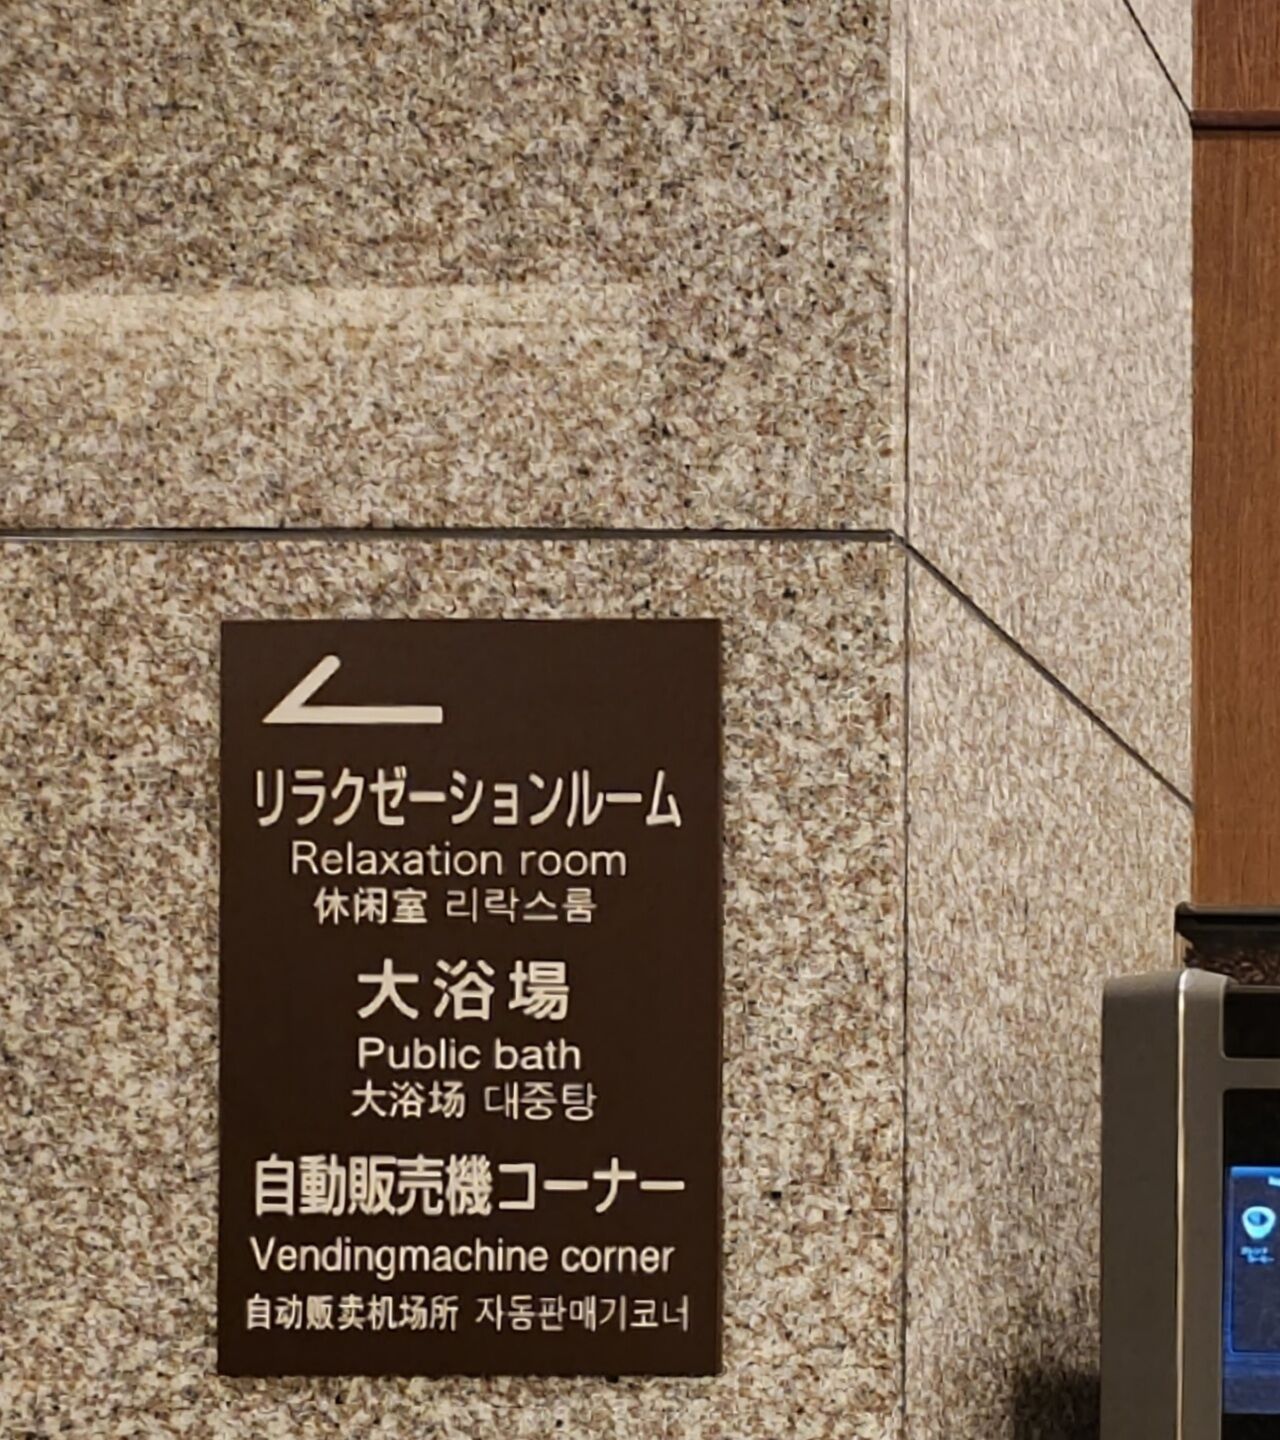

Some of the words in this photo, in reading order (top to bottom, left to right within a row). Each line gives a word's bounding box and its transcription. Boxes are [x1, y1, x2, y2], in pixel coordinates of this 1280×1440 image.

[255, 766, 682, 829] リラクゼーションルーム
[290, 841, 504, 877] Relaxation
[519, 849, 628, 877] room
[314, 886, 429, 925] 休闲室
[446, 886, 598, 925] 리락스룸
[357, 957, 571, 1021] 大浴場
[356, 1037, 482, 1071] Public
[494, 1038, 582, 1071] bath
[351, 1079, 466, 1119] 大浴场
[483, 1081, 599, 1122] 대중탕
[254, 1153, 686, 1218] 自動販売機コーナー
[249, 1236, 549, 1281] Vendingmachine
[560, 1243, 676, 1273] corner
[245, 1294, 459, 1332] 自动贩卖机场所
[474, 1294, 690, 1333] 자동판매기코너
